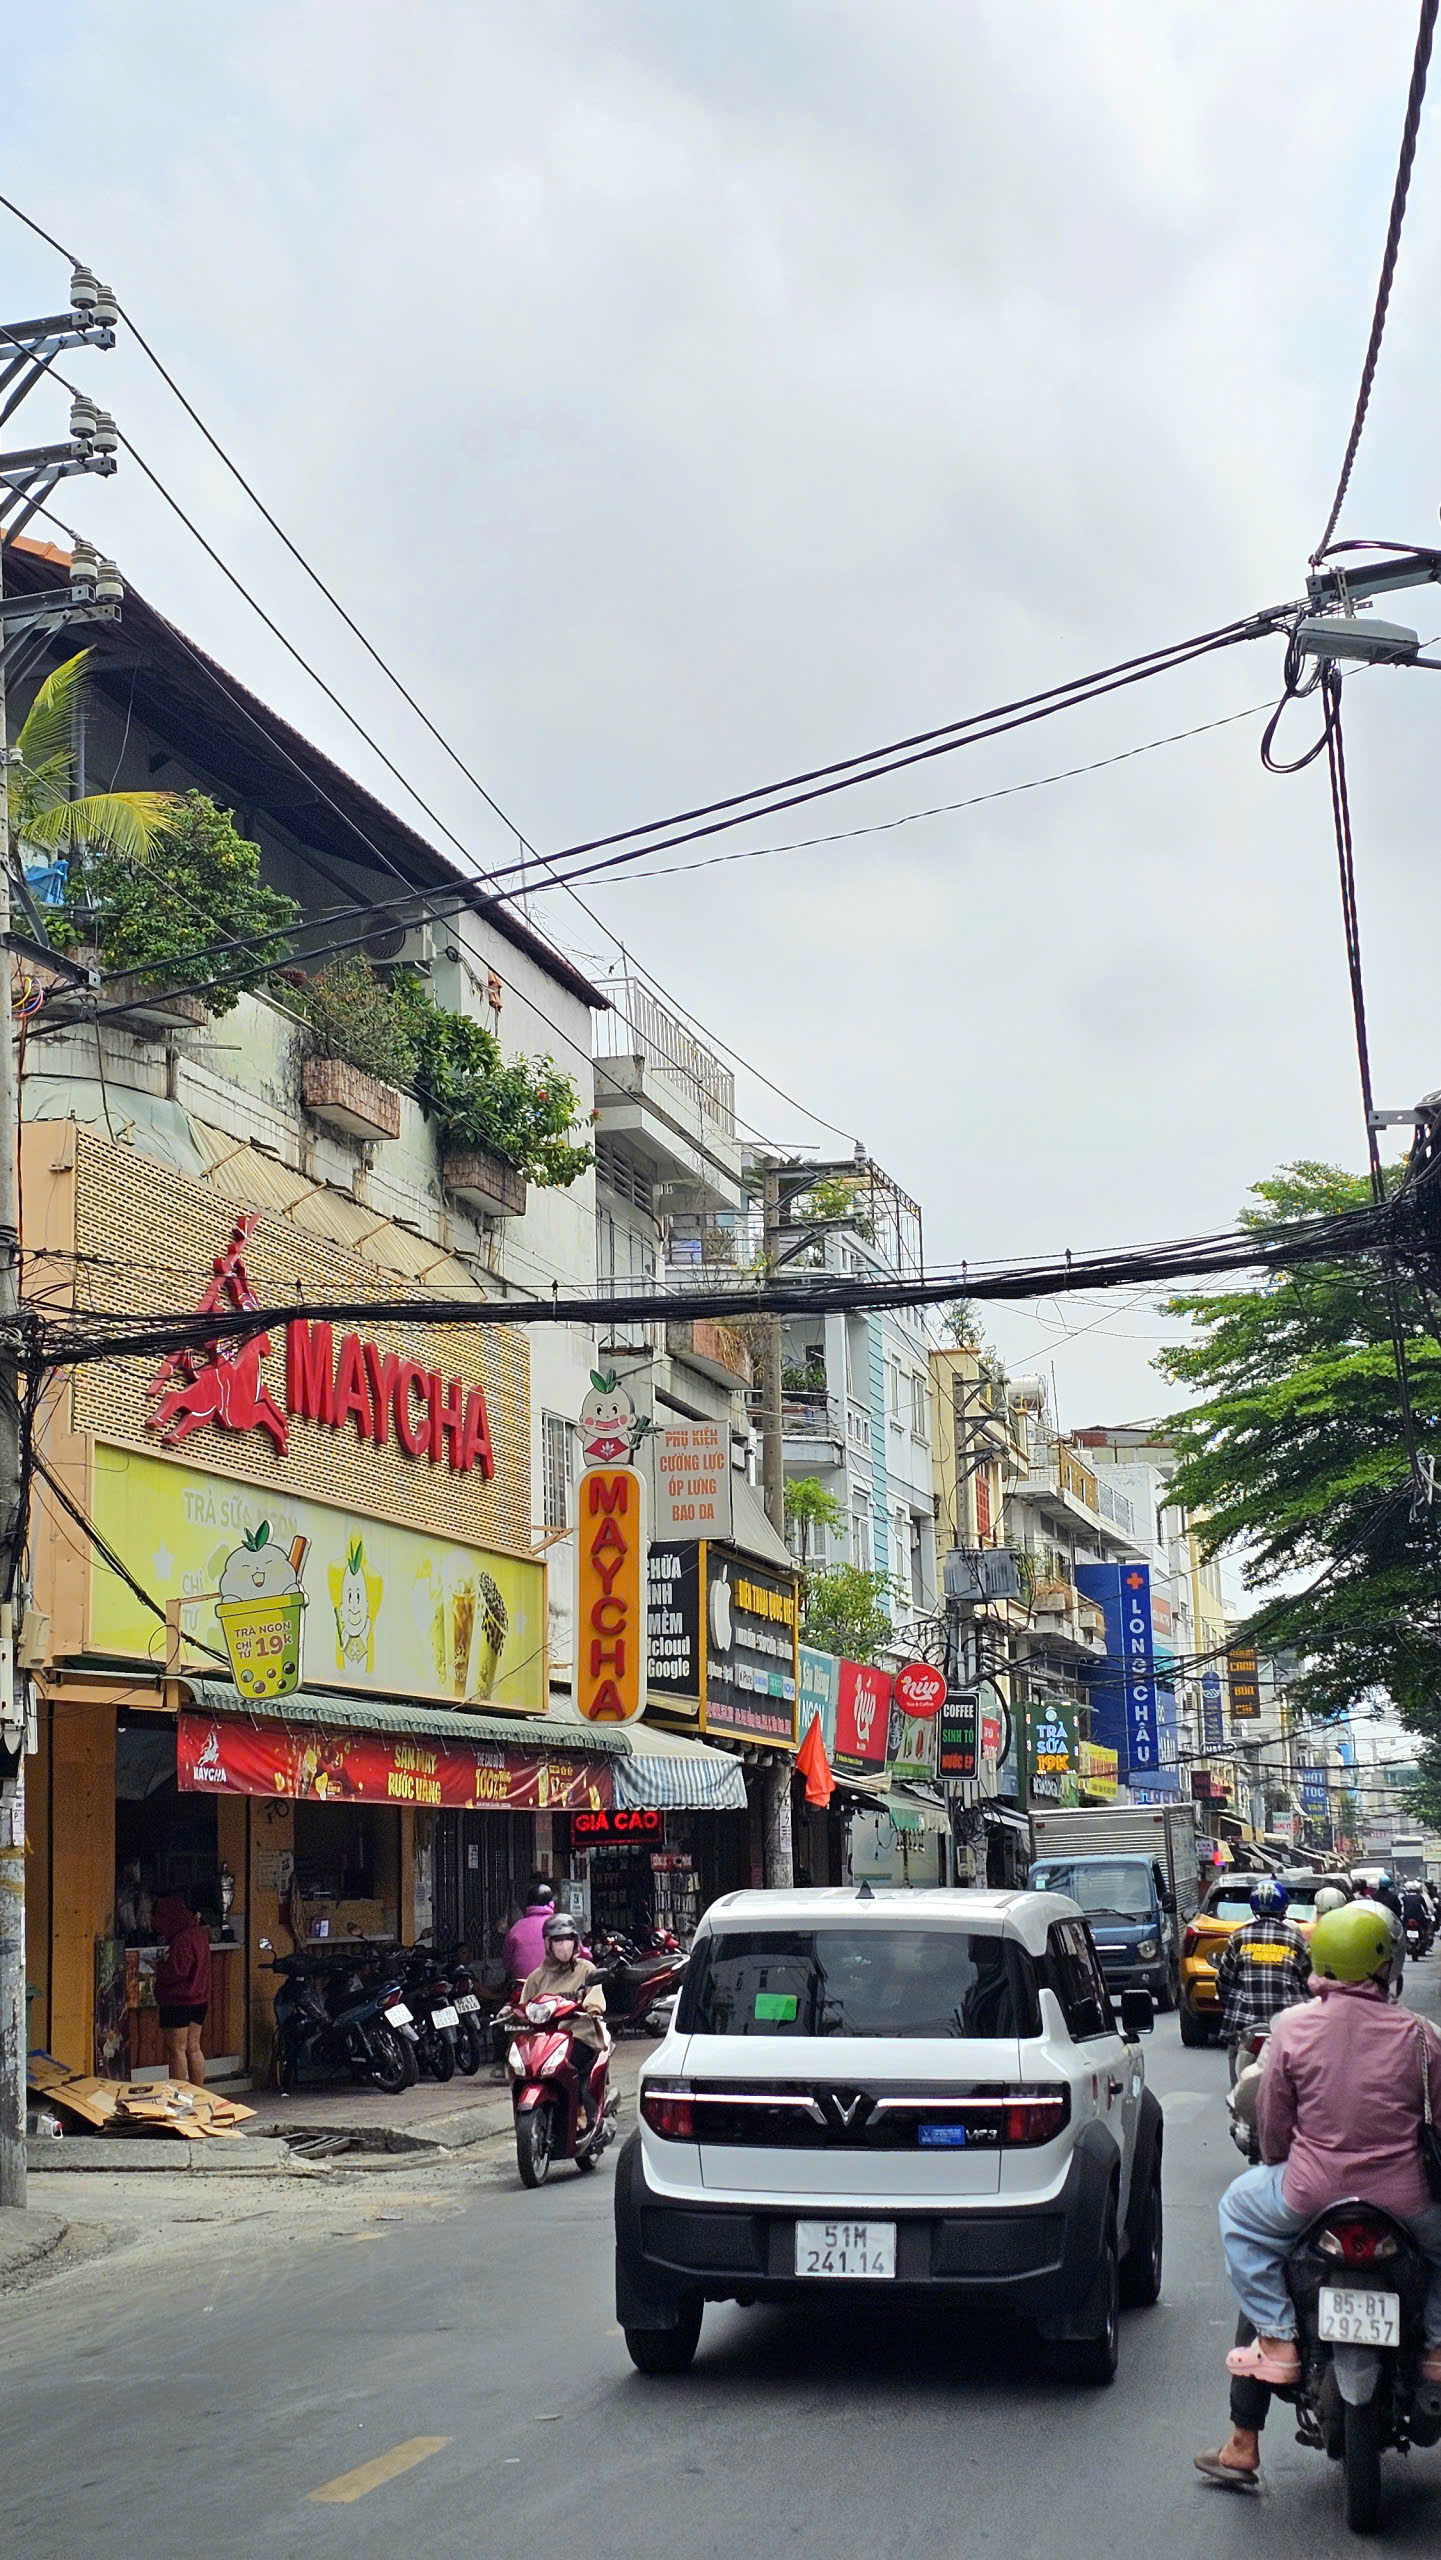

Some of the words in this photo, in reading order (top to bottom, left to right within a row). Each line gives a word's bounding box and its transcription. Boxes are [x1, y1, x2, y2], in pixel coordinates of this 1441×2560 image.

[287, 1318, 495, 1481] MAYCHA
[672, 1504, 696, 1522] BAO
[698, 1503, 715, 1520] DA
[588, 1475, 629, 1721] MAYCHA
[234, 1625, 256, 1638] TRÀ
[259, 1621, 291, 1634] NGON
[1129, 1599, 1148, 1675] LONG
[255, 1633, 292, 1657] 19k
[647, 1657, 690, 1680] Google
[901, 1675, 940, 1701] húp
[943, 1704, 974, 1718] COFFEE
[1035, 1720, 1069, 1738] TRÀ
[1132, 1685, 1151, 1762] CHÂU
[942, 1728, 962, 1743] SINH
[1035, 1737, 1070, 1754] SỮA
[193, 1766, 227, 1783] MAYCHA
[1036, 1755, 1070, 1771] 19K
[614, 1811, 658, 1830] CAO
[824, 2224, 867, 2248] 51M
[806, 2250, 885, 2273] 241.14
[1333, 2292, 1386, 2318] 85-B1
[1322, 2315, 1394, 2344] 292.57
